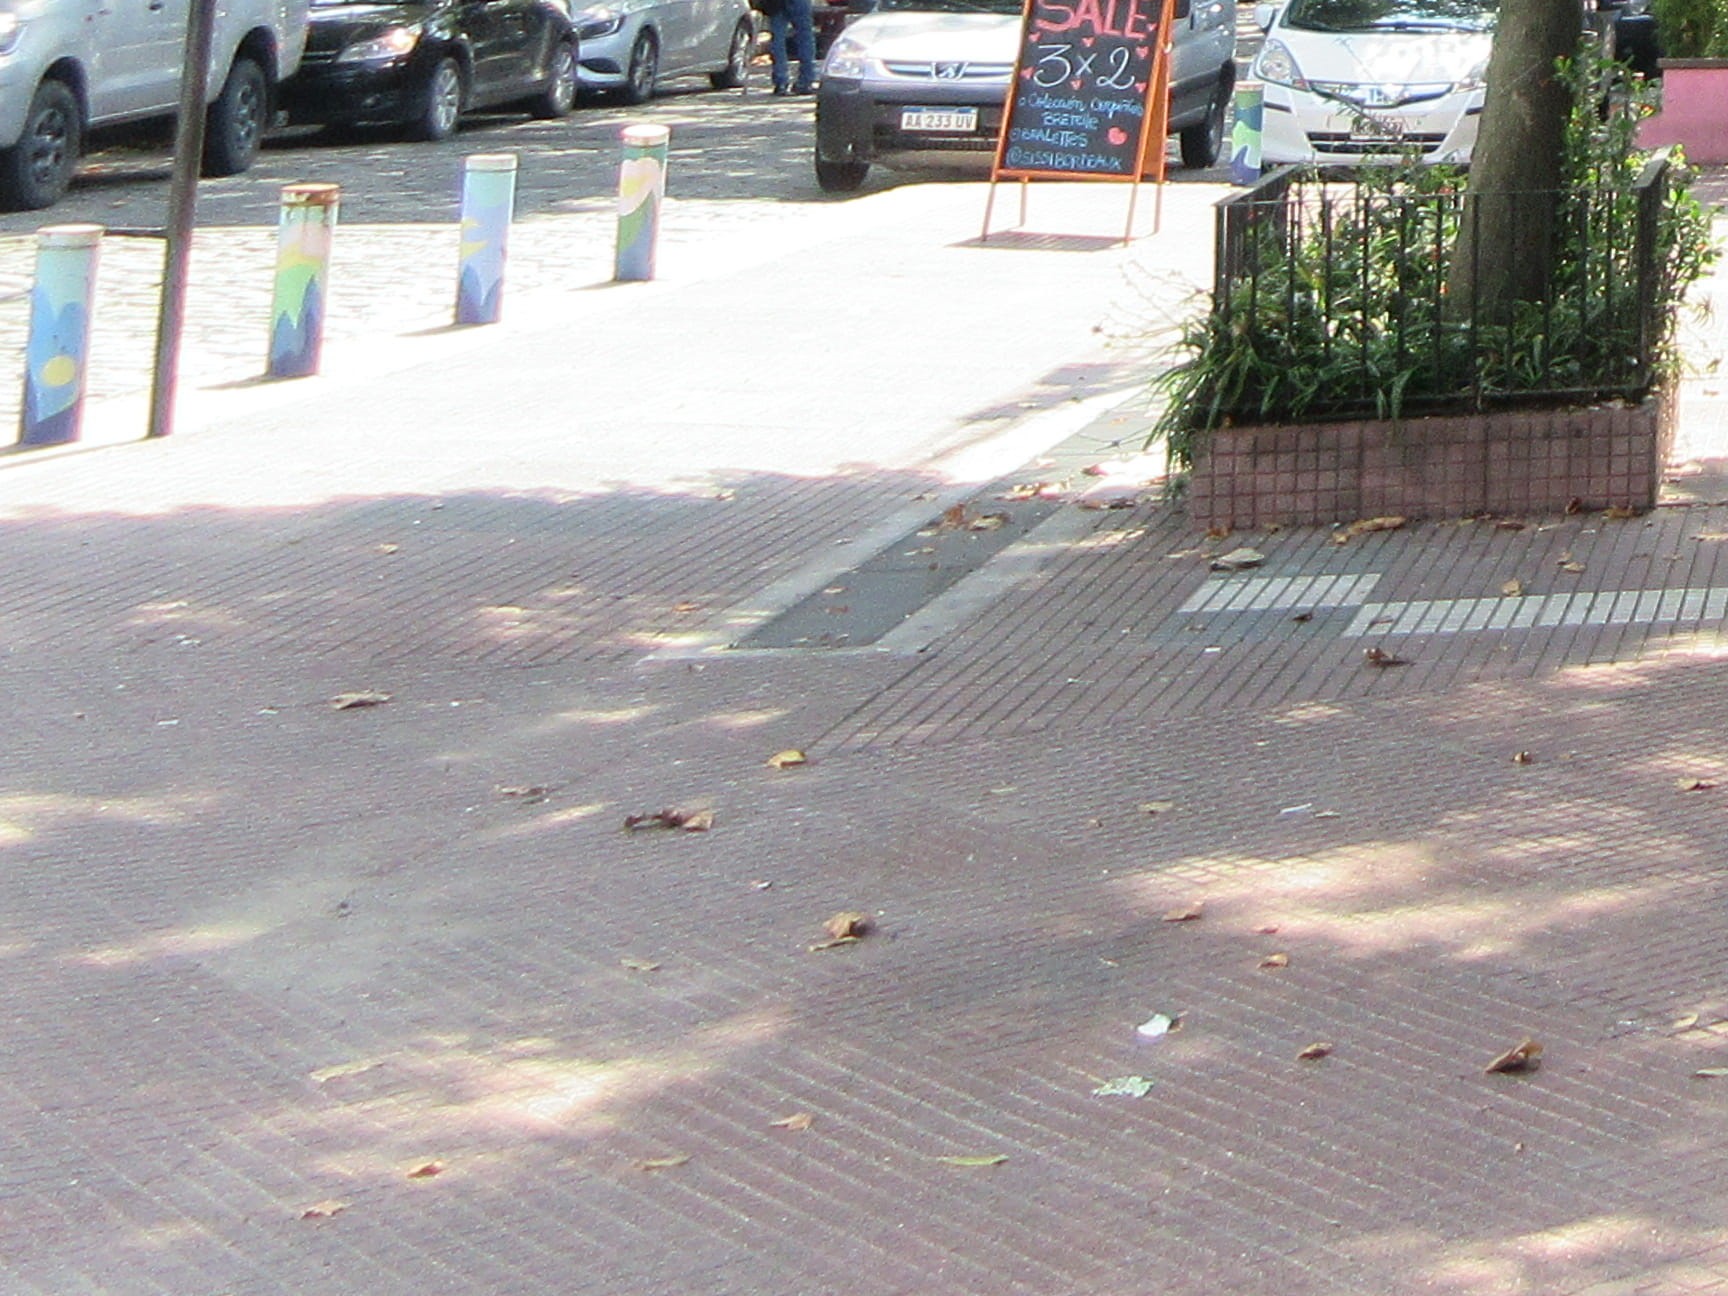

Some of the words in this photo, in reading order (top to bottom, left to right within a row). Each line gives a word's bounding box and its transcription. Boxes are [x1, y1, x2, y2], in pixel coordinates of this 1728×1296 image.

[905, 114, 922, 128] AA
[925, 114, 952, 129] 233
[955, 115, 974, 129] UV
